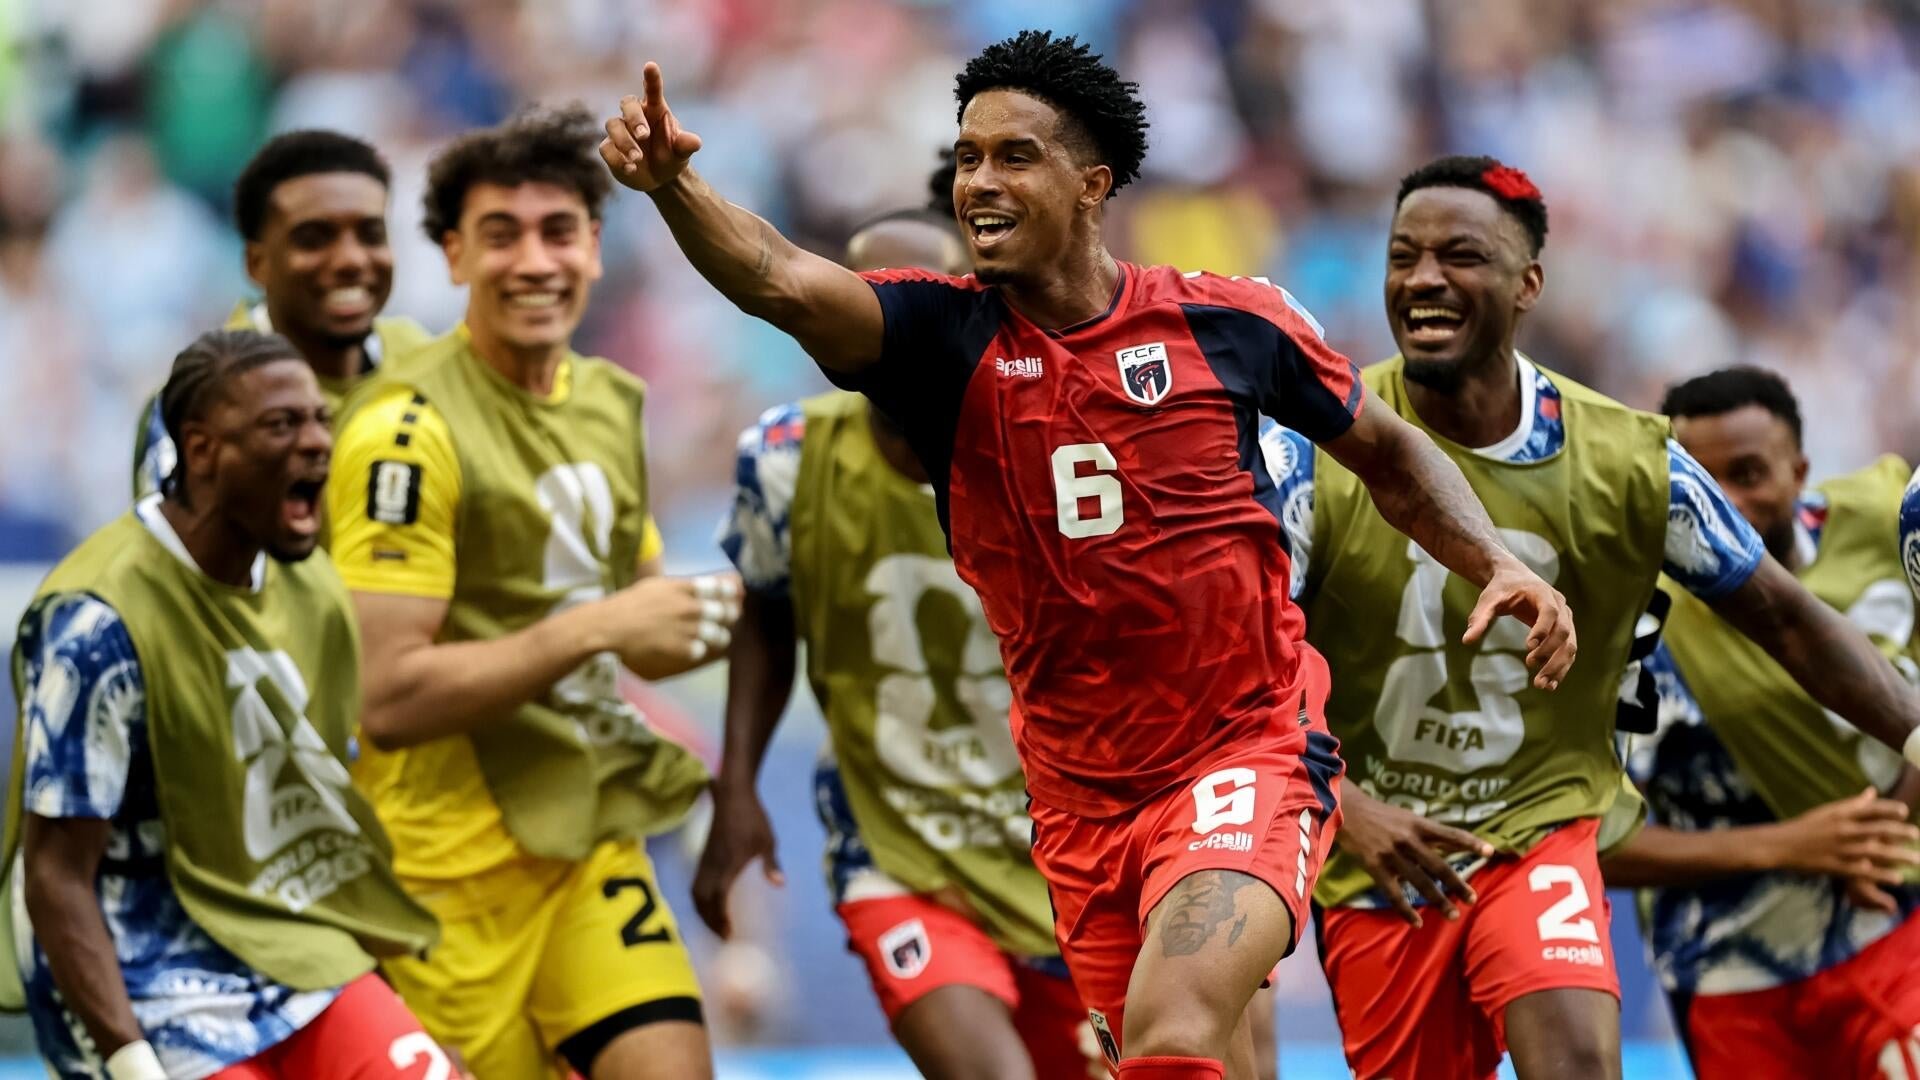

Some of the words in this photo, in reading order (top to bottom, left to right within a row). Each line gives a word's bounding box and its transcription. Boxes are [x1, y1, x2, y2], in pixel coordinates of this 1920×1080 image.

[995, 357, 1043, 377] apelli
[1121, 345, 1160, 362] FCF
[1051, 442, 1124, 539] 6
[1414, 718, 1485, 751] FIFA
[1191, 767, 1257, 835] 6
[1366, 754, 1457, 798] WORLD
[602, 877, 673, 948] 2
[1528, 863, 1600, 943] 2
[388, 1030, 452, 1080] 2
